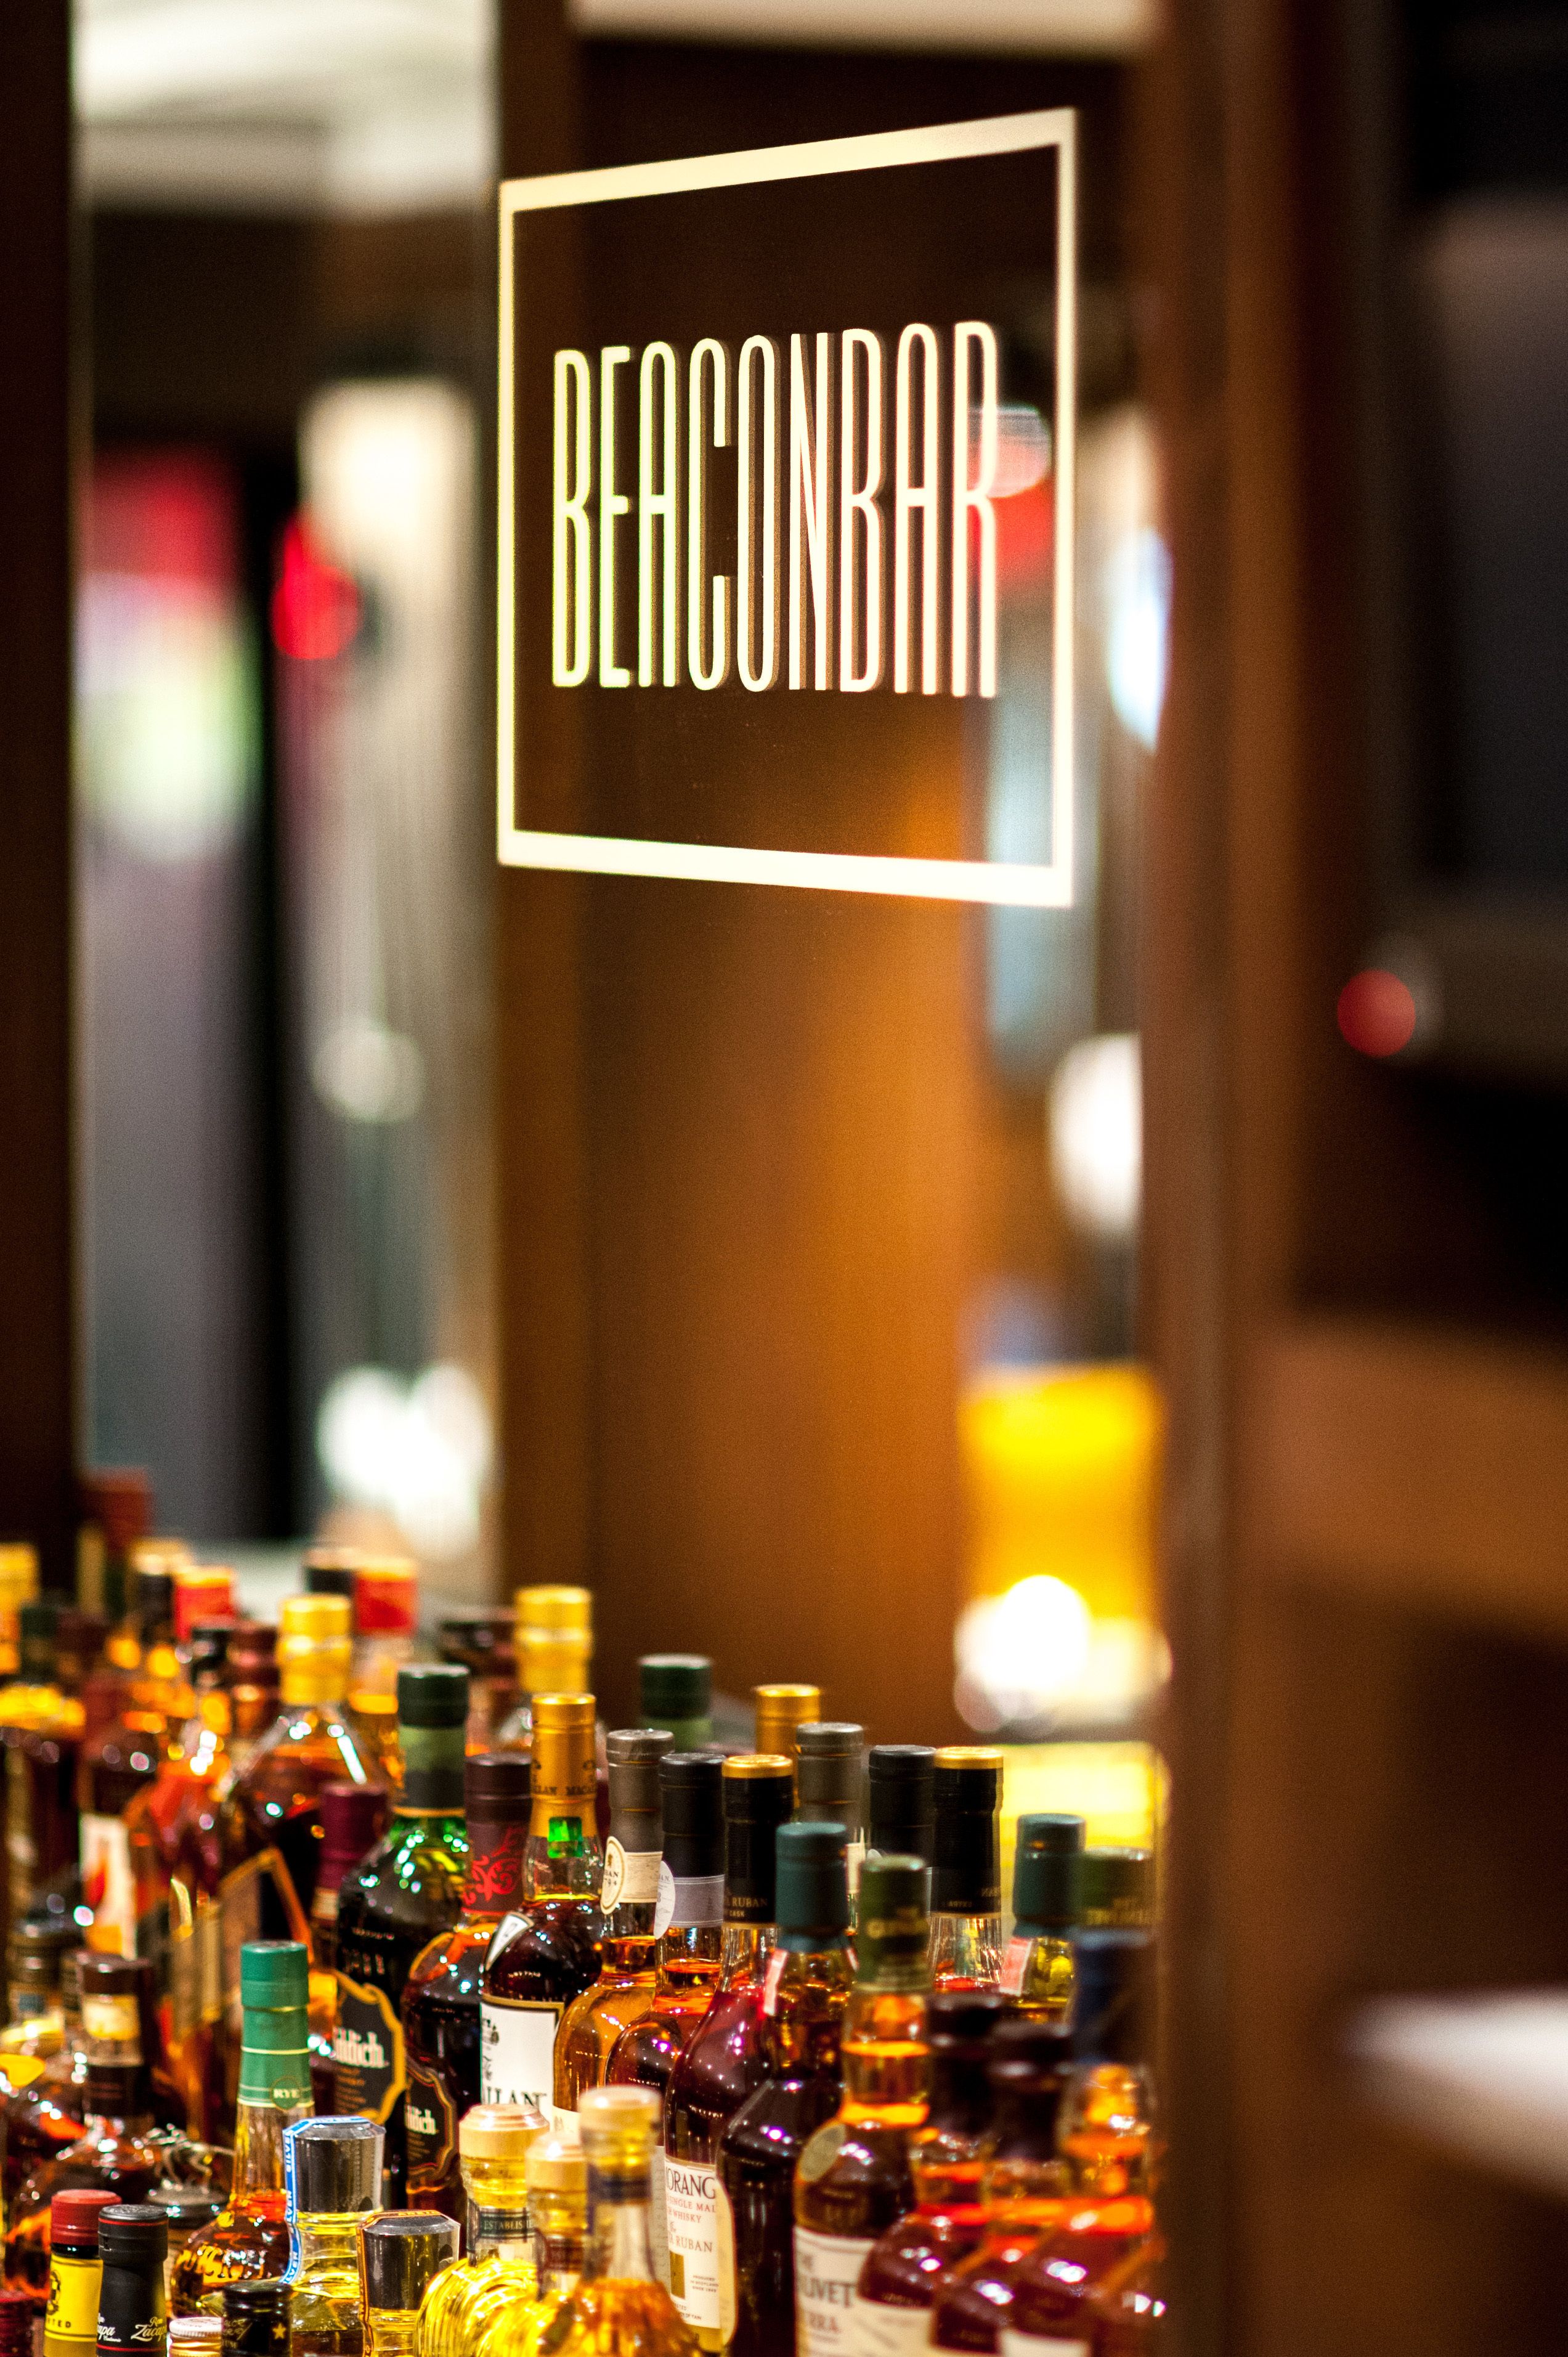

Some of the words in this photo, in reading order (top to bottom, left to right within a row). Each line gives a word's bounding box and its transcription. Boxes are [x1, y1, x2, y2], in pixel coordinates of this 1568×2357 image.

[732, 1897, 768, 1907] RUBAN
[273, 2088, 299, 2099] RYE
[676, 2235, 713, 2253] RUBAN
